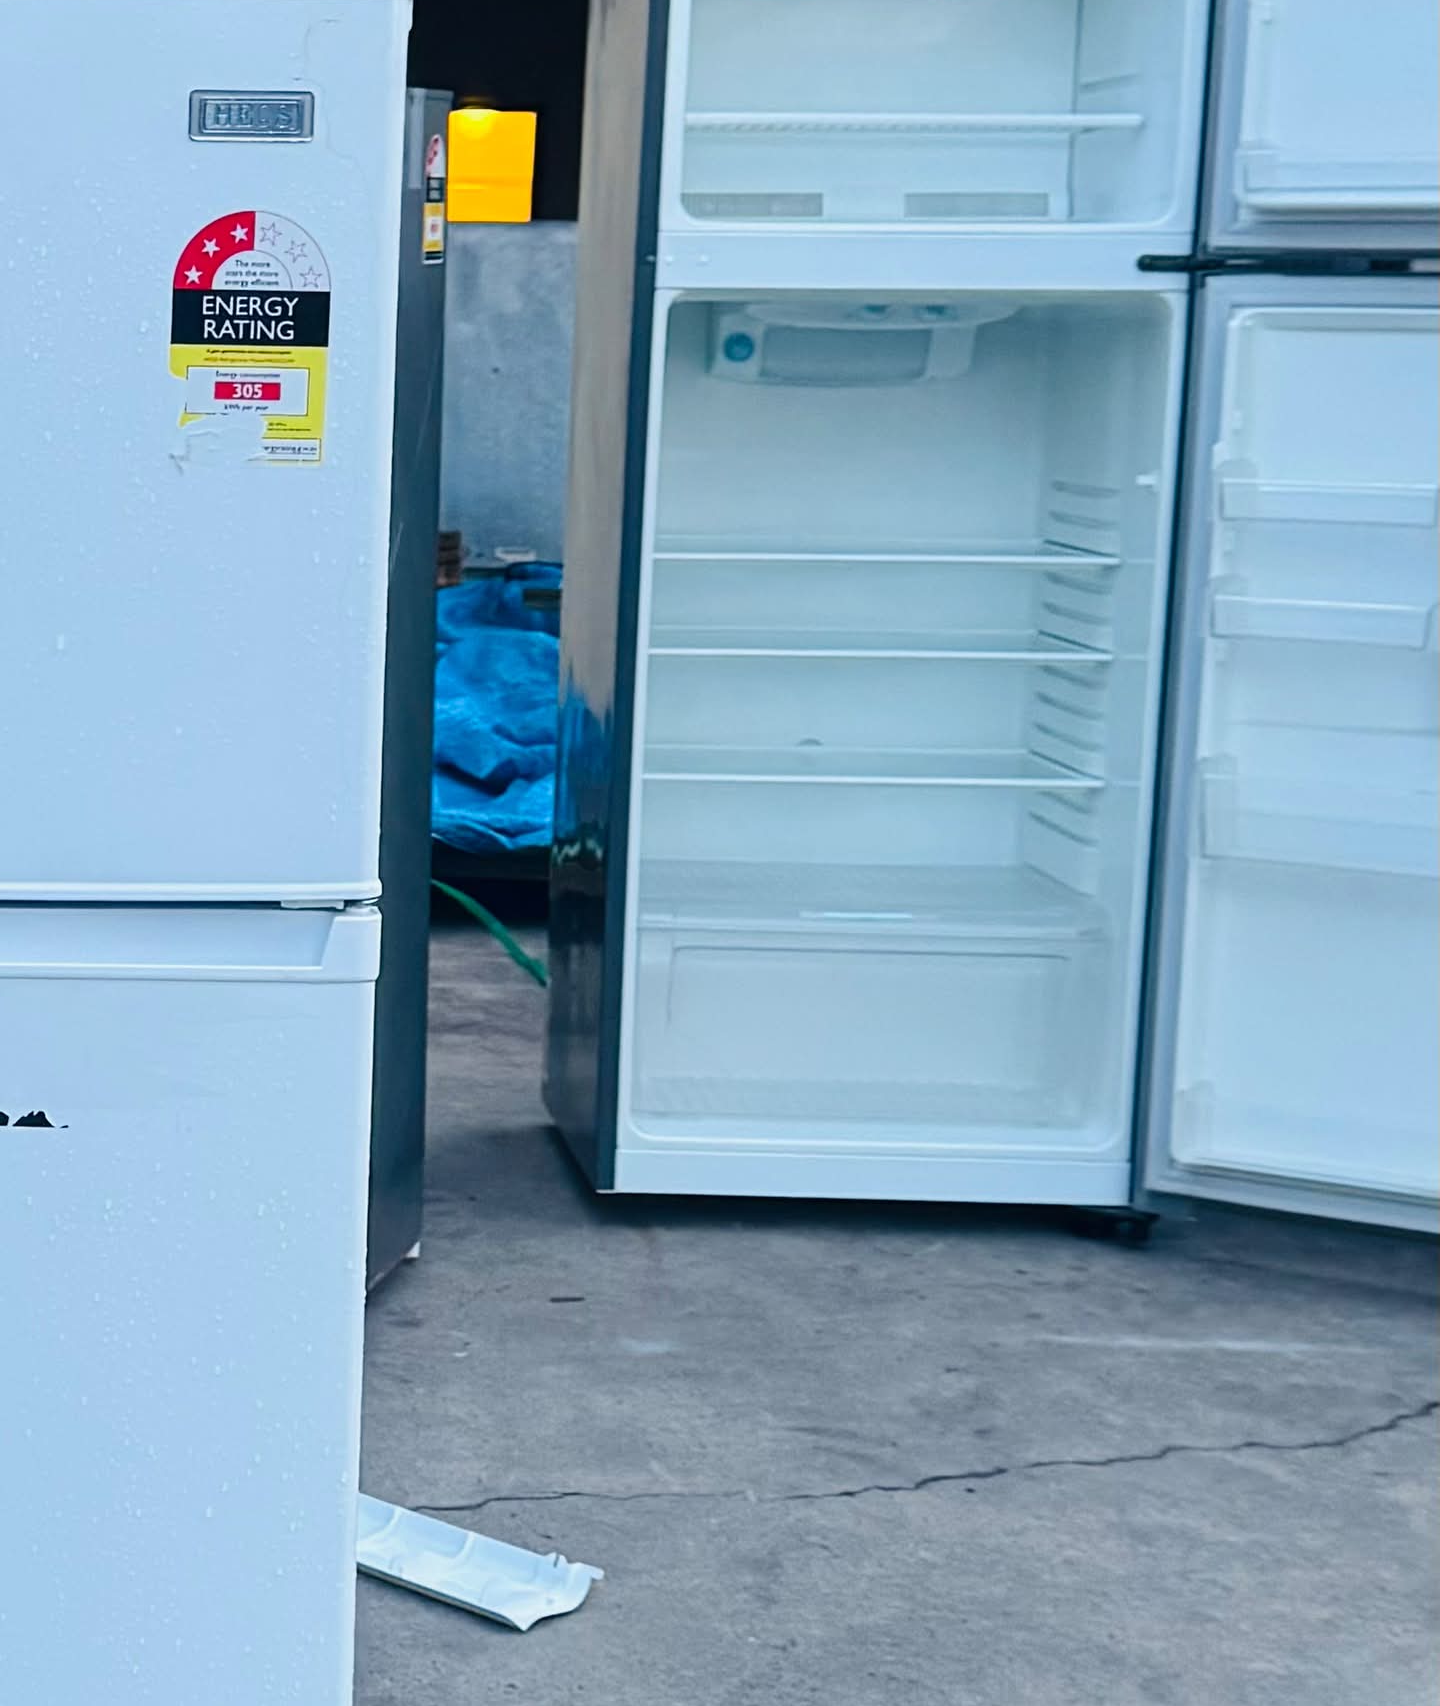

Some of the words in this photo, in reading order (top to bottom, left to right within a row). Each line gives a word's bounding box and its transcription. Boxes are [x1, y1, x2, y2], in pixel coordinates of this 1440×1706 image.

[202, 295, 299, 317] ENERGY
[203, 319, 295, 340] RATING
[232, 384, 263, 398] 305
